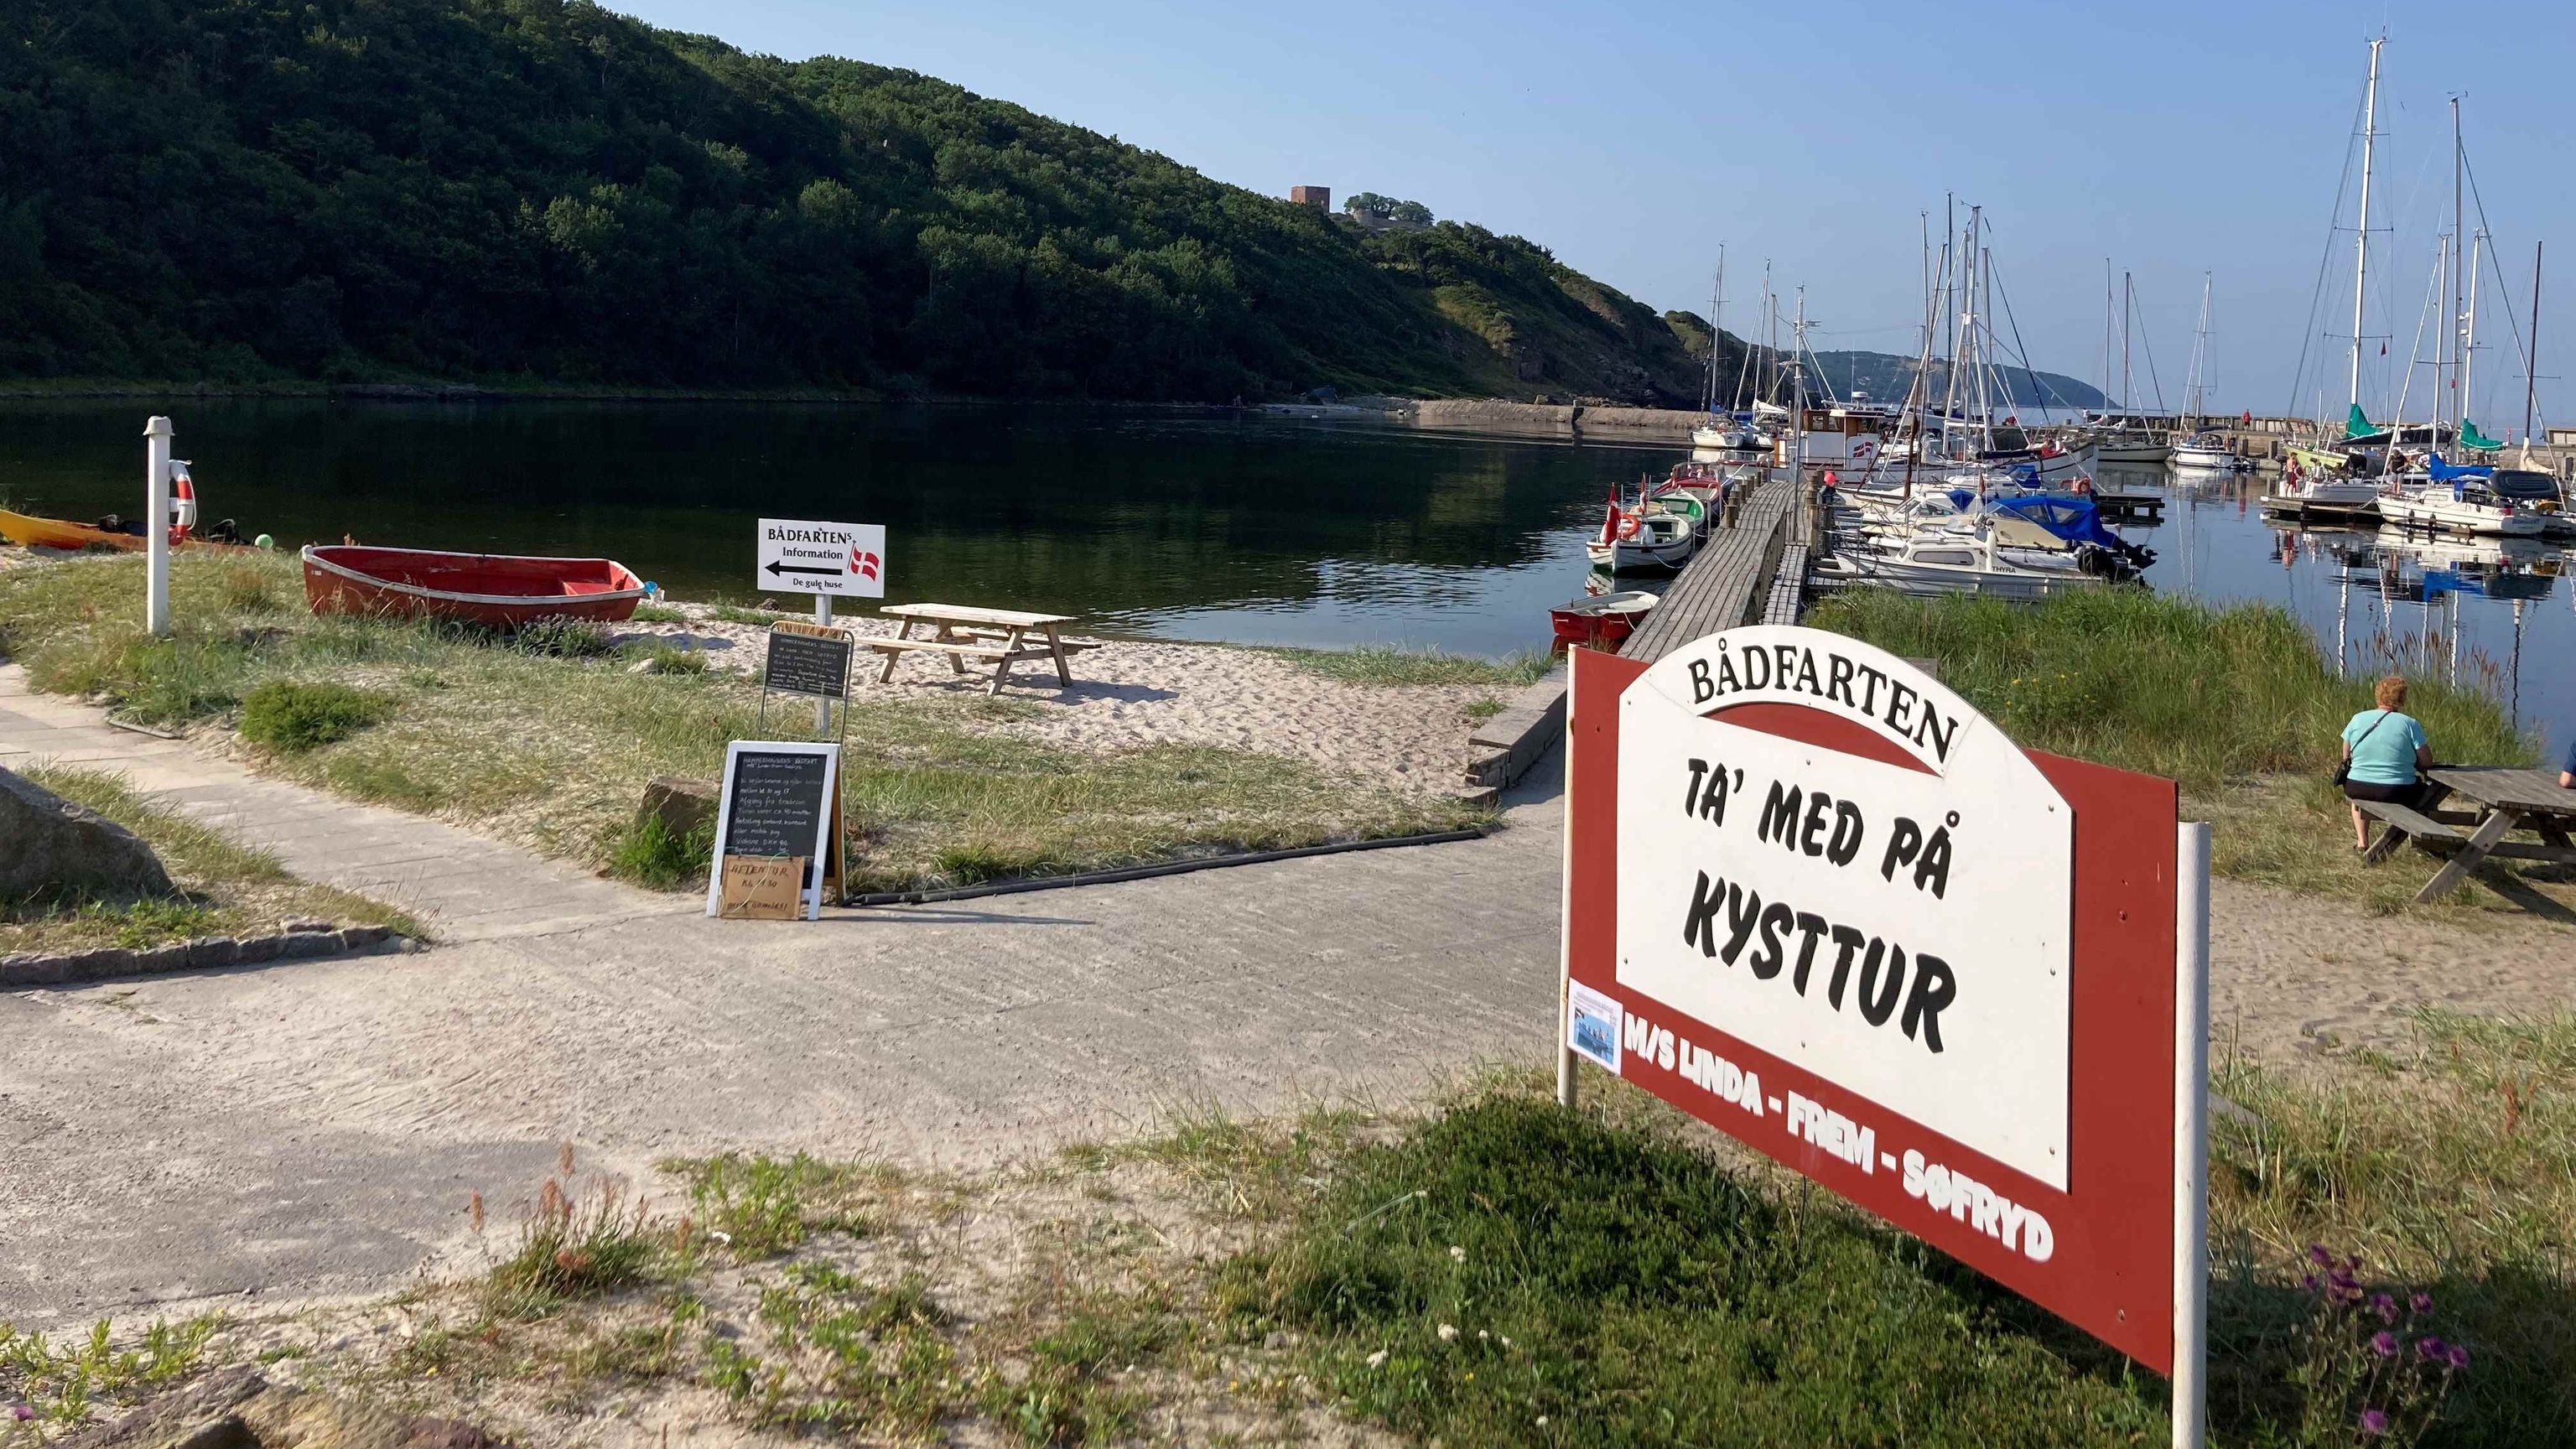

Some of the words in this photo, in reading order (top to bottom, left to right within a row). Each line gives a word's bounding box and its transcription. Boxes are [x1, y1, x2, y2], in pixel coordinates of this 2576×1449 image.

[782, 547, 843, 559] Information
[792, 578, 803, 586] De
[805, 579, 822, 588] gule
[1688, 637, 1959, 764] BÅDFARTEN
[1685, 758, 1744, 828] TA'
[1758, 779, 1864, 867] MED
[1881, 810, 1961, 900] PÅ
[1684, 869, 1957, 1054] KYSTTUR
[1624, 1011, 1676, 1072] M/S
[1679, 1037, 1764, 1117] LINDA
[1787, 1089, 1875, 1175] FREM
[1903, 1148, 2054, 1262] SØFRYD
